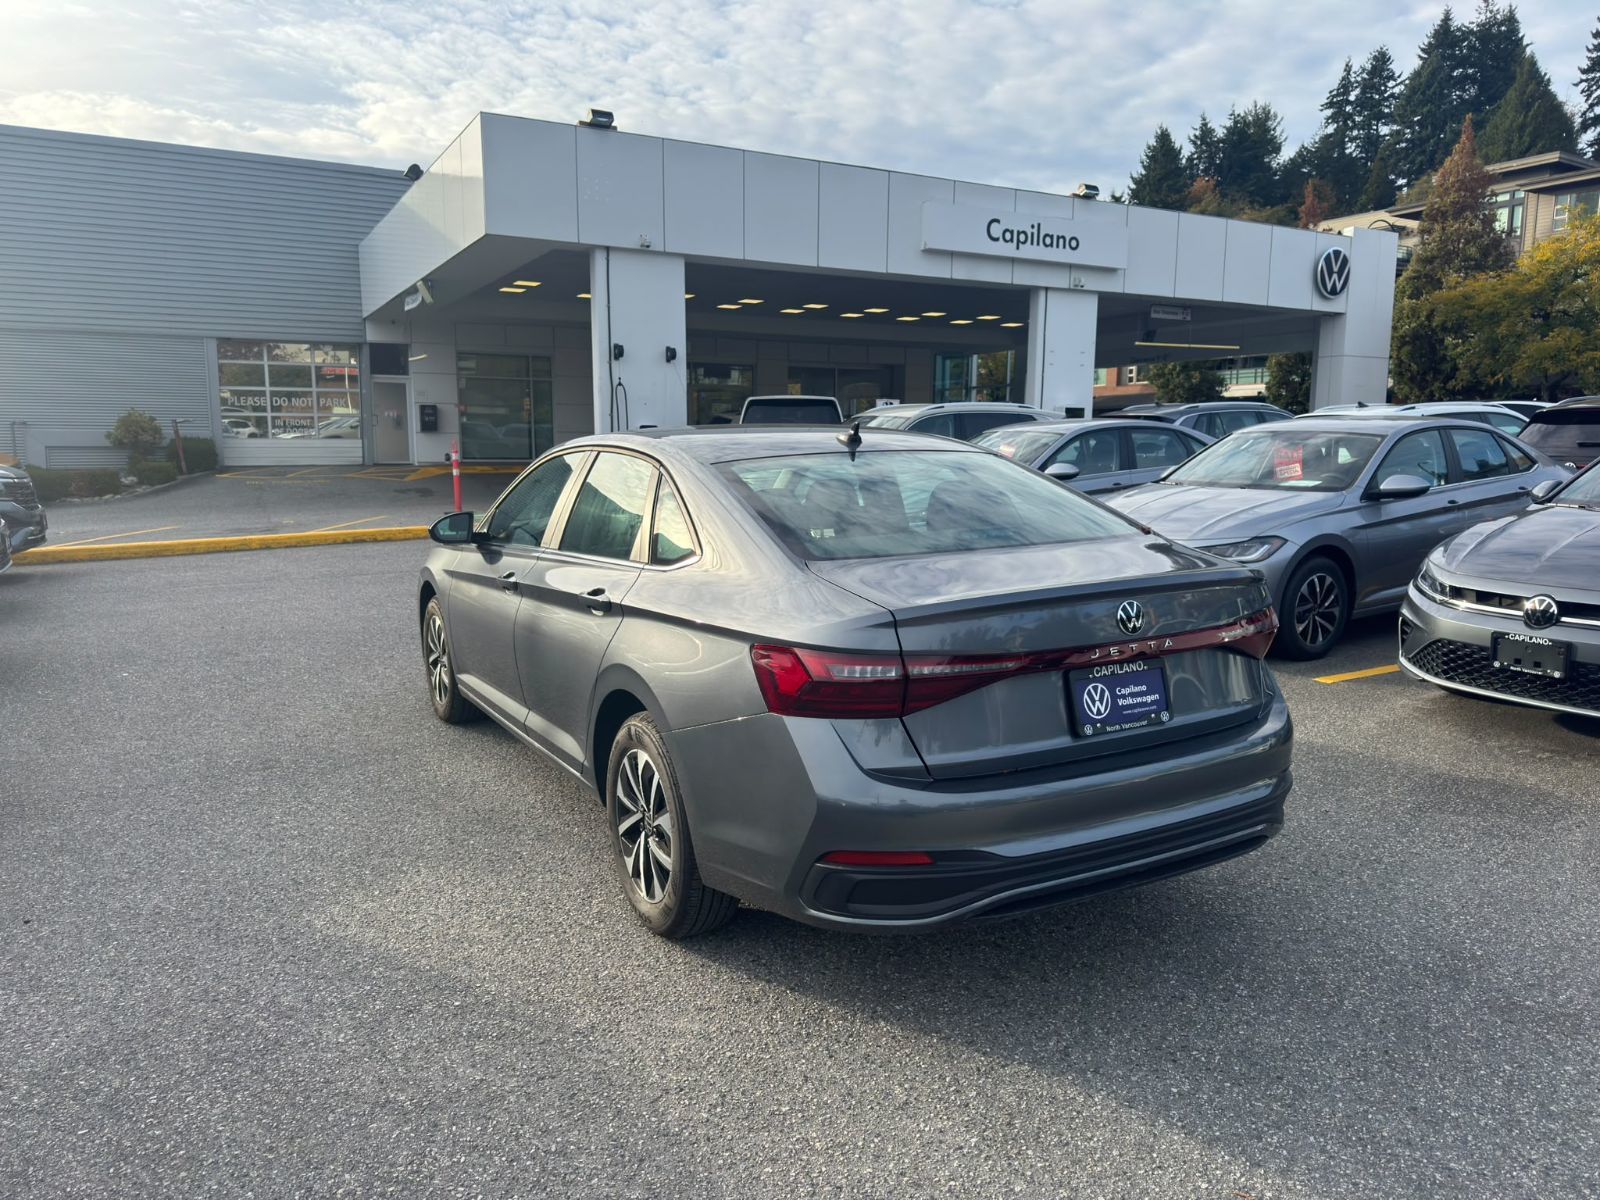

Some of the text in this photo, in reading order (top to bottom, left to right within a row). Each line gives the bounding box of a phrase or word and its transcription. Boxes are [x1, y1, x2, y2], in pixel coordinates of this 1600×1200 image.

[986, 218, 1080, 251] Capilano
[227, 396, 346, 408] PLEASE DO NOT PARK
[286, 419, 312, 427] FRONT
[1508, 633, 1549, 645] CAPILANO
[1090, 638, 1173, 659] JETTA
[1093, 660, 1144, 677] CAPILANO
[1116, 684, 1147, 696] Capilano
[1117, 693, 1160, 706] Volkswagen
[1106, 720, 1148, 732] North Vancouver
